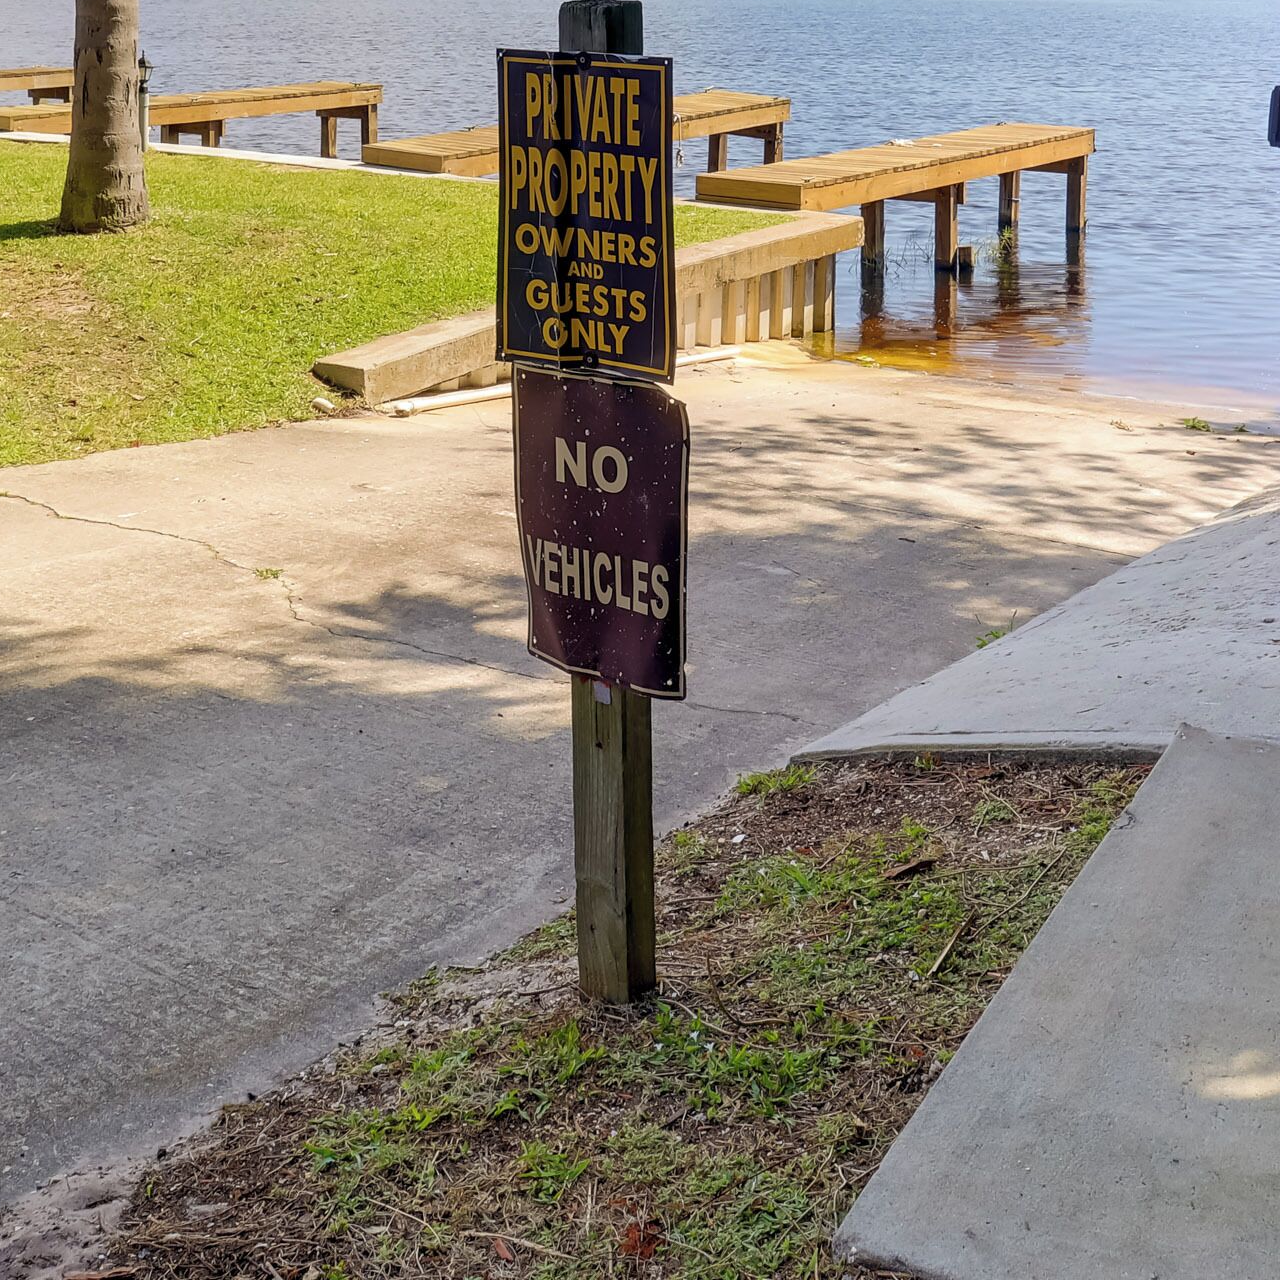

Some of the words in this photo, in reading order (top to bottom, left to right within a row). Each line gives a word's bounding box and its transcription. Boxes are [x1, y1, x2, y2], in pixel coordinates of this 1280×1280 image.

[526, 72, 640, 146] PRIVATE
[511, 145, 659, 225] PROPERTY
[515, 222, 657, 269] OWNERS
[568, 259, 604, 281] AND
[526, 279, 647, 322] GUESTS
[542, 317, 631, 355] ONLY
[555, 436, 629, 494] NO
[526, 534, 669, 620] VEHICLES
